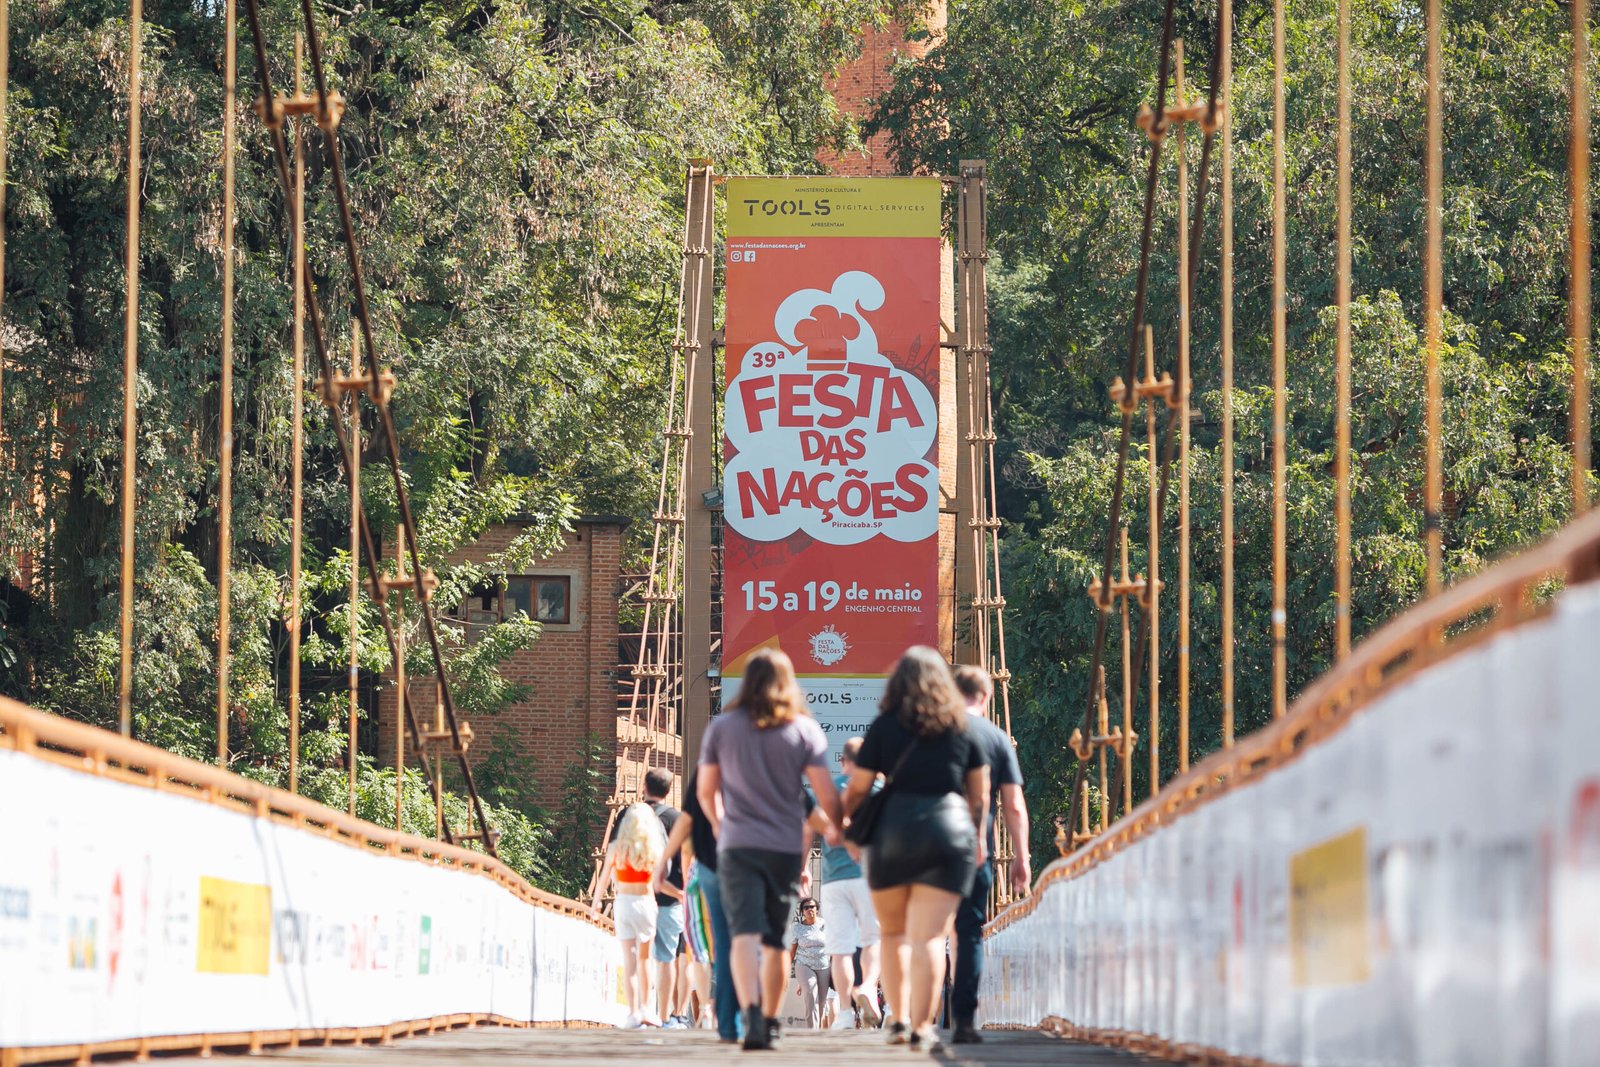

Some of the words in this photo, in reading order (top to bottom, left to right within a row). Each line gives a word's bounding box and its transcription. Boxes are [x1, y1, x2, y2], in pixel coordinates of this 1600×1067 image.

[743, 199, 831, 216] TOOLS
[730, 242, 807, 250] www.festadasnacoes.org.br
[752, 351, 785, 368] 39ª
[738, 361, 925, 434] FESTA
[799, 428, 867, 467] DAS
[736, 462, 930, 524] NAÇÕES
[831, 521, 883, 529] Piracicaba.SP
[741, 580, 779, 611] 15
[782, 592, 799, 611] a
[803, 580, 841, 612] 19
[845, 581, 869, 601] de
[874, 582, 923, 601] maio
[844, 604, 886, 613] ENGENHO
[886, 604, 923, 613] CENTRAL
[805, 692, 853, 704] OOLS
[836, 724, 871, 732] HYUND
